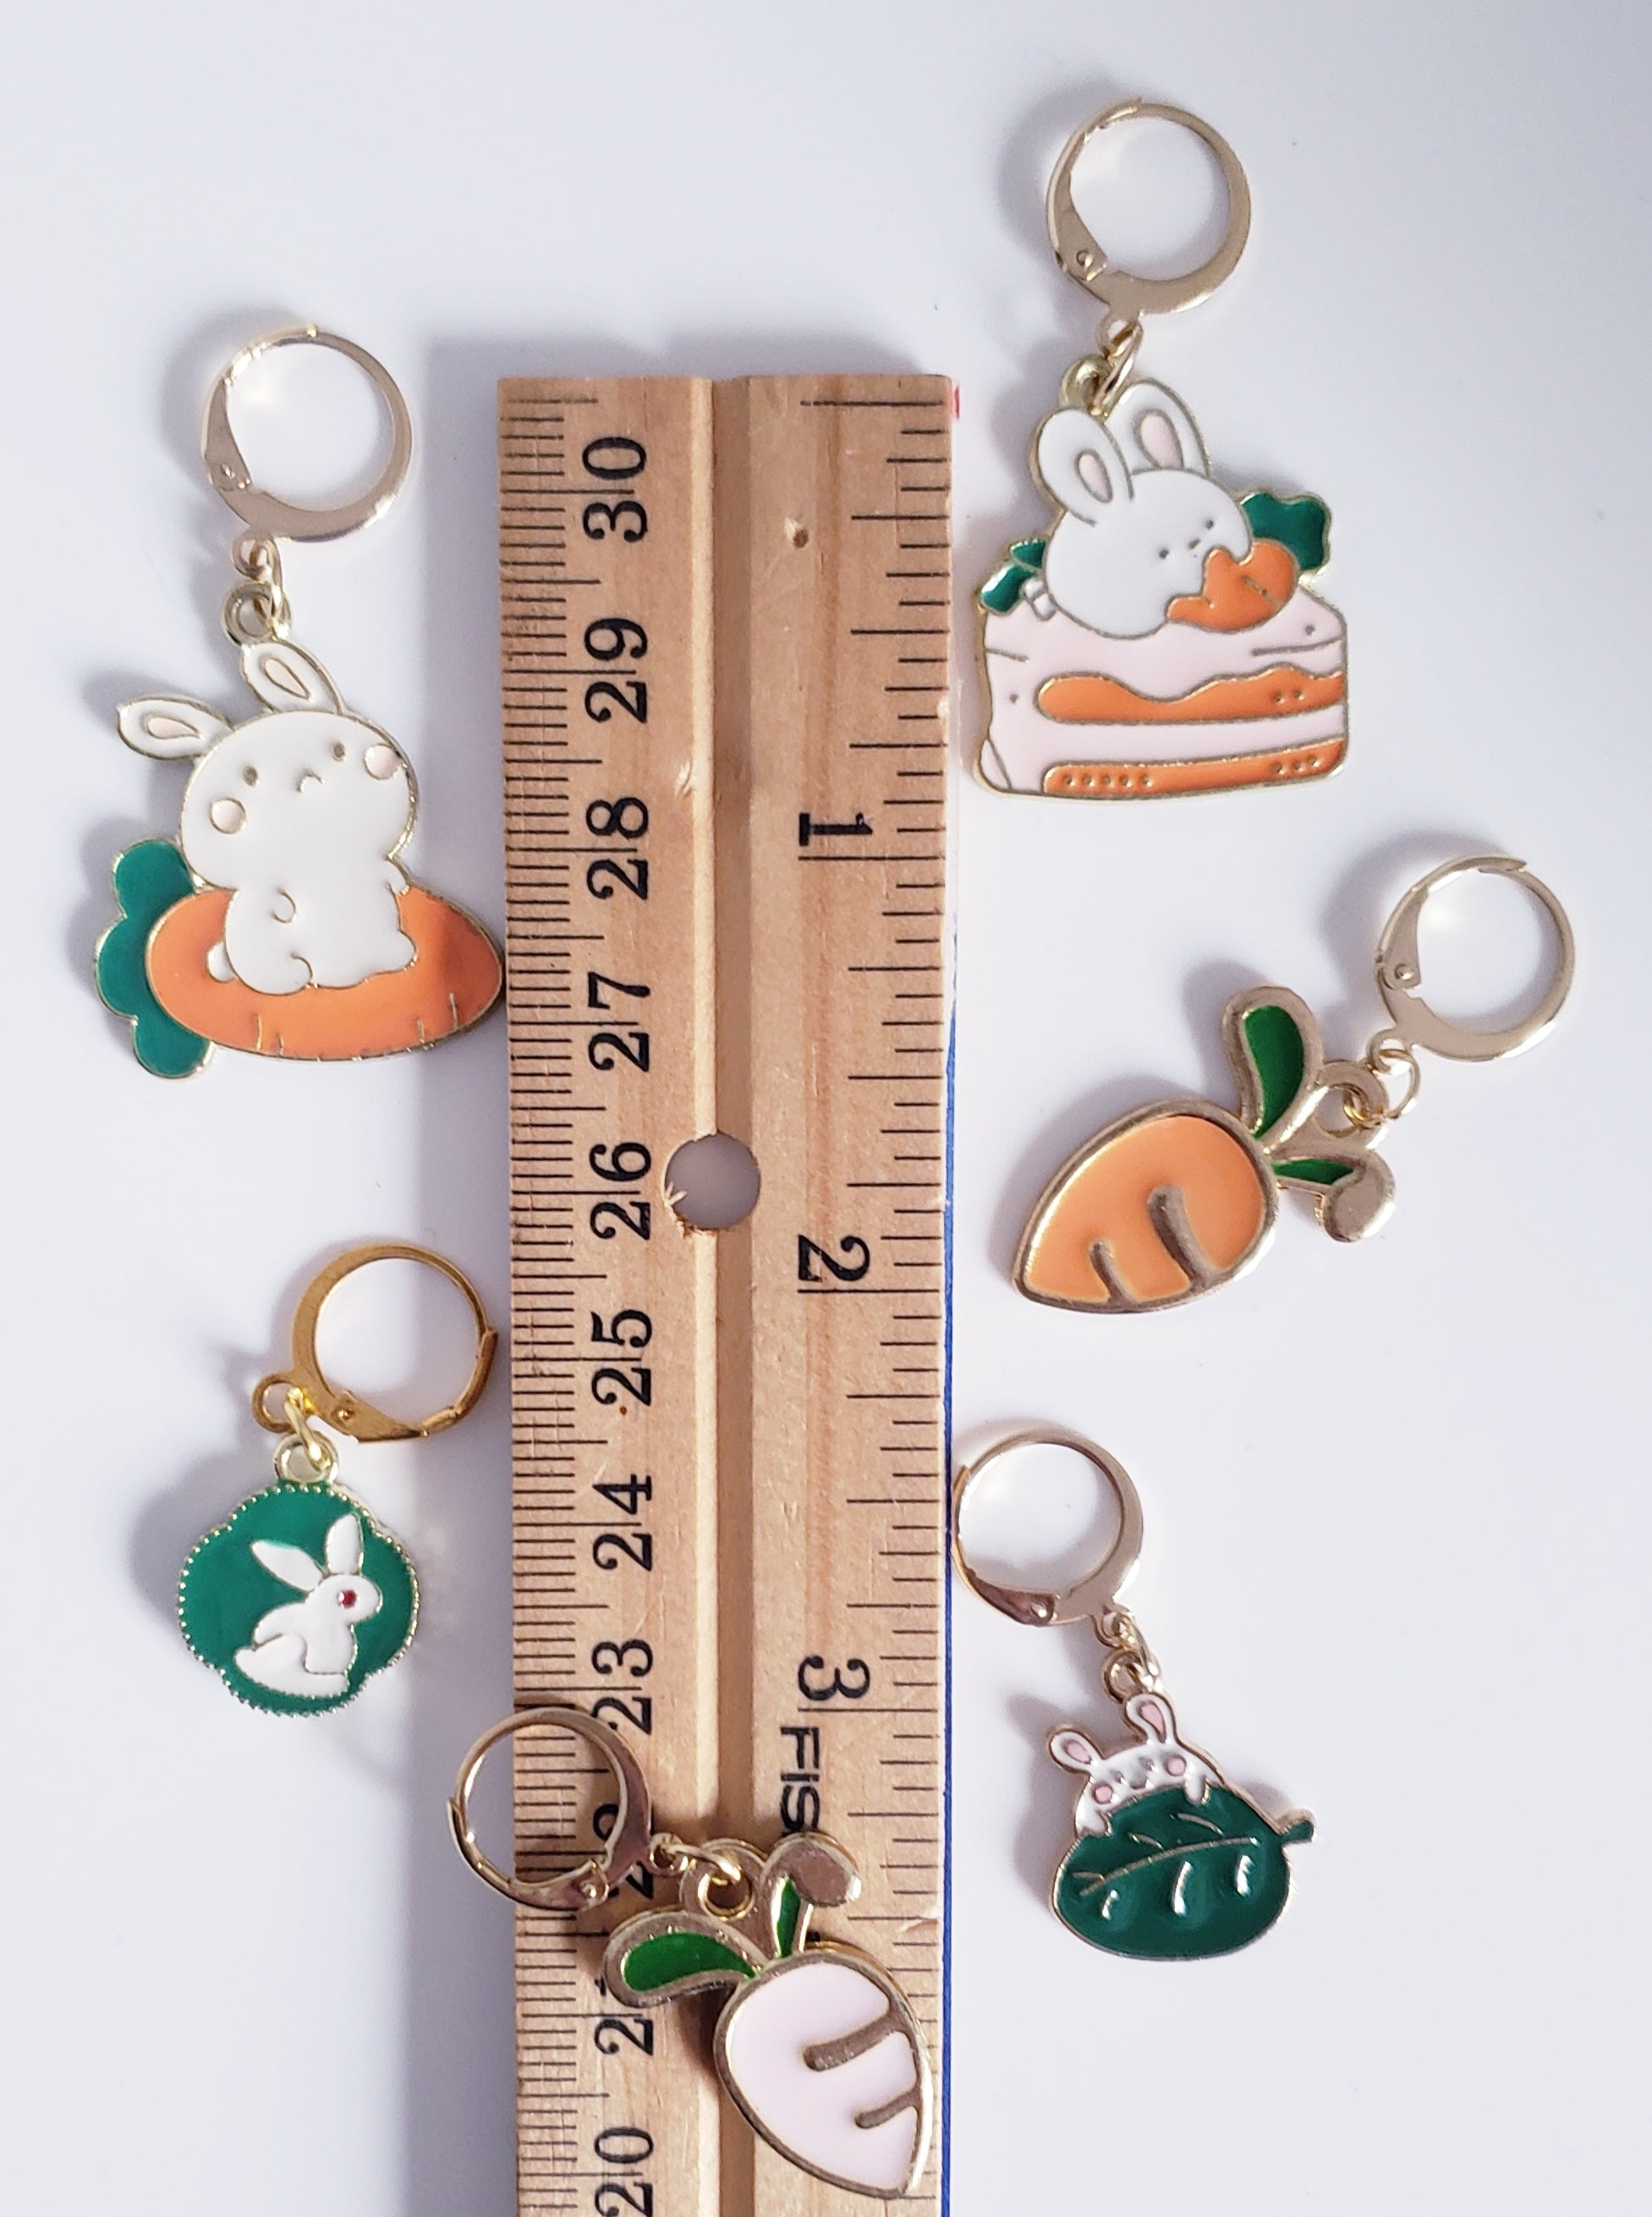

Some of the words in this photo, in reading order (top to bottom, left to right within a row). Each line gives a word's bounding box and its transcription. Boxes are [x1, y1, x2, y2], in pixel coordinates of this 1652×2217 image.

[582, 436, 648, 543] 30
[584, 617, 648, 723] 29
[585, 796, 649, 901] 28
[799, 812, 873, 847] 1
[588, 971, 650, 1073] 27
[590, 1142, 651, 1241] 26
[798, 1234, 870, 1282] 2
[591, 1309, 652, 1407] 25
[592, 1473, 653, 1572] 24
[591, 1638, 653, 1736] 23
[798, 1655, 870, 1701] 3
[594, 2126, 654, 2217] 20
